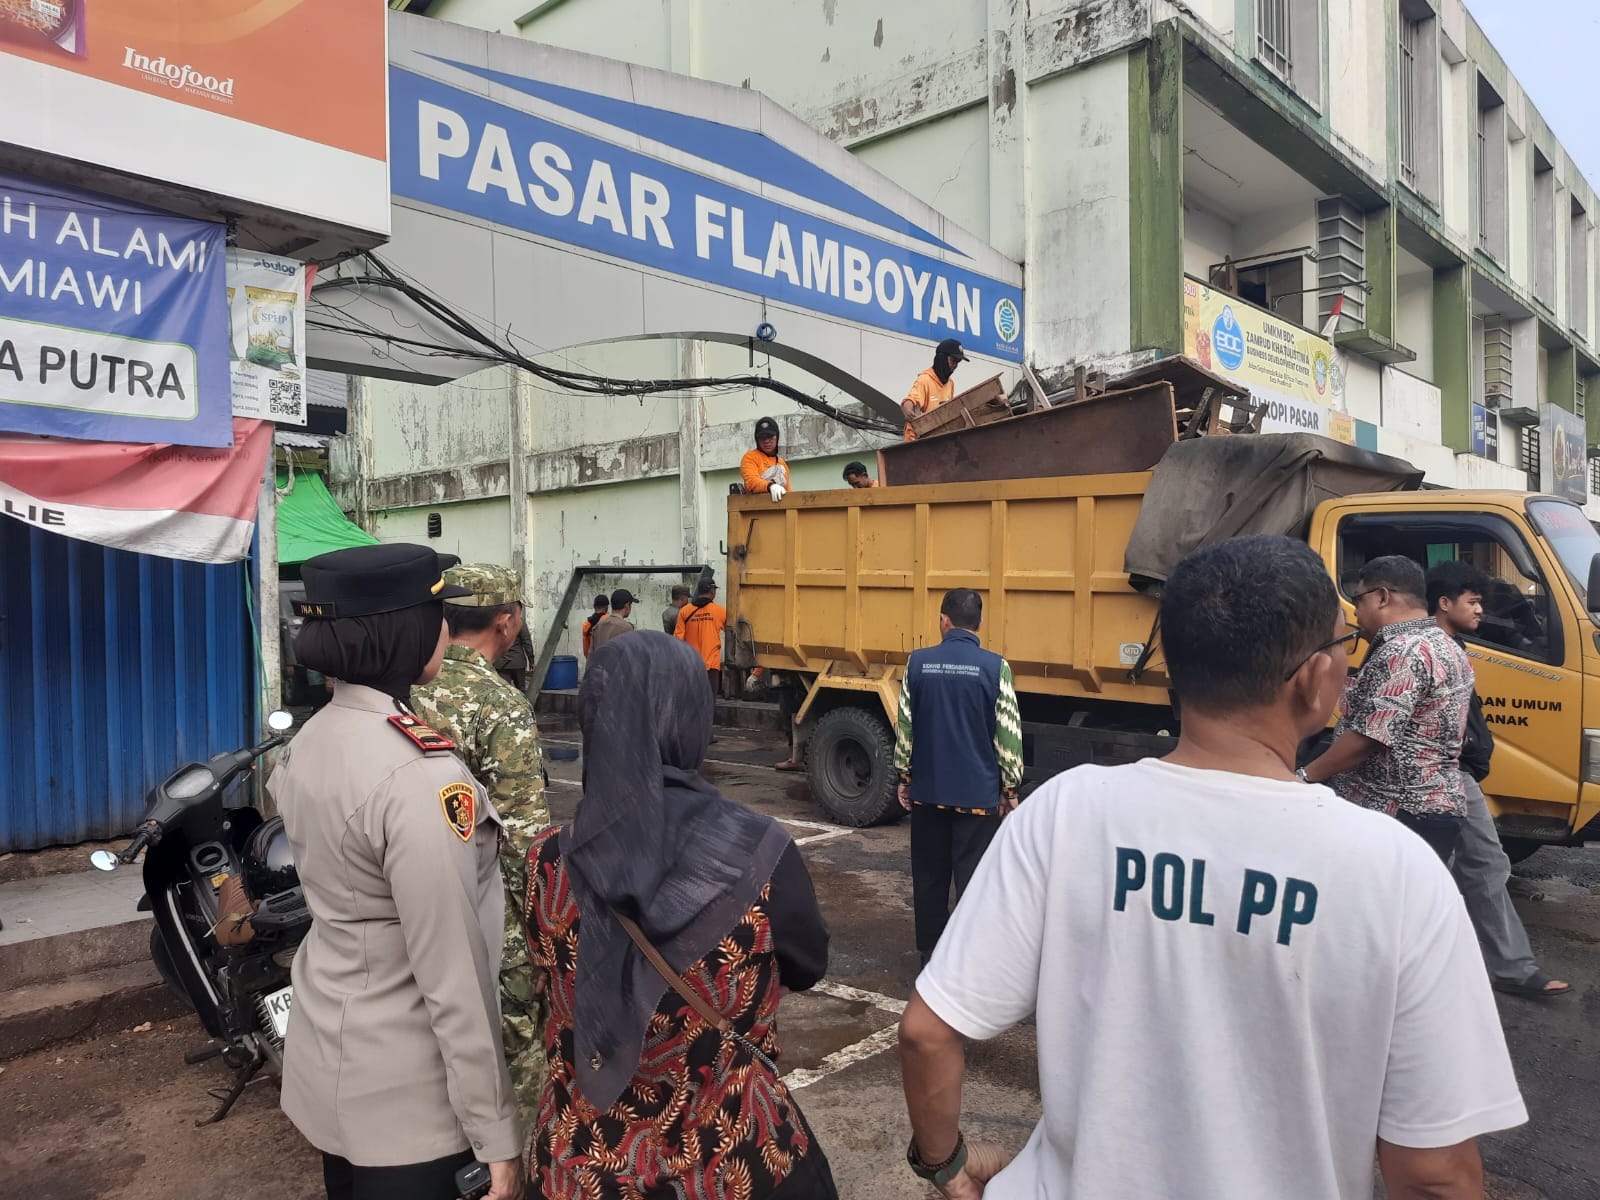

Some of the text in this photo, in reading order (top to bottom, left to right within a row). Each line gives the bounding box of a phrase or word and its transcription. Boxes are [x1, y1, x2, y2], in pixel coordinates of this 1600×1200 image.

[122, 46, 235, 96] Indofood
[418, 99, 981, 337] PASAR FLAMBOYAN
[55, 211, 206, 273] ALAMI
[262, 259, 296, 277] bulog
[261, 312, 288, 324] SPHP
[1216, 329, 1242, 352] BDC
[1263, 321, 1283, 341] UMKM
[39, 345, 186, 411] PUTRA
[1289, 406, 1319, 430] PASAR
[5, 499, 66, 527] LIE
[1511, 698, 1562, 712] UMUM
[1485, 713, 1529, 727] ANAK
[1113, 846, 1318, 946] POL PP
